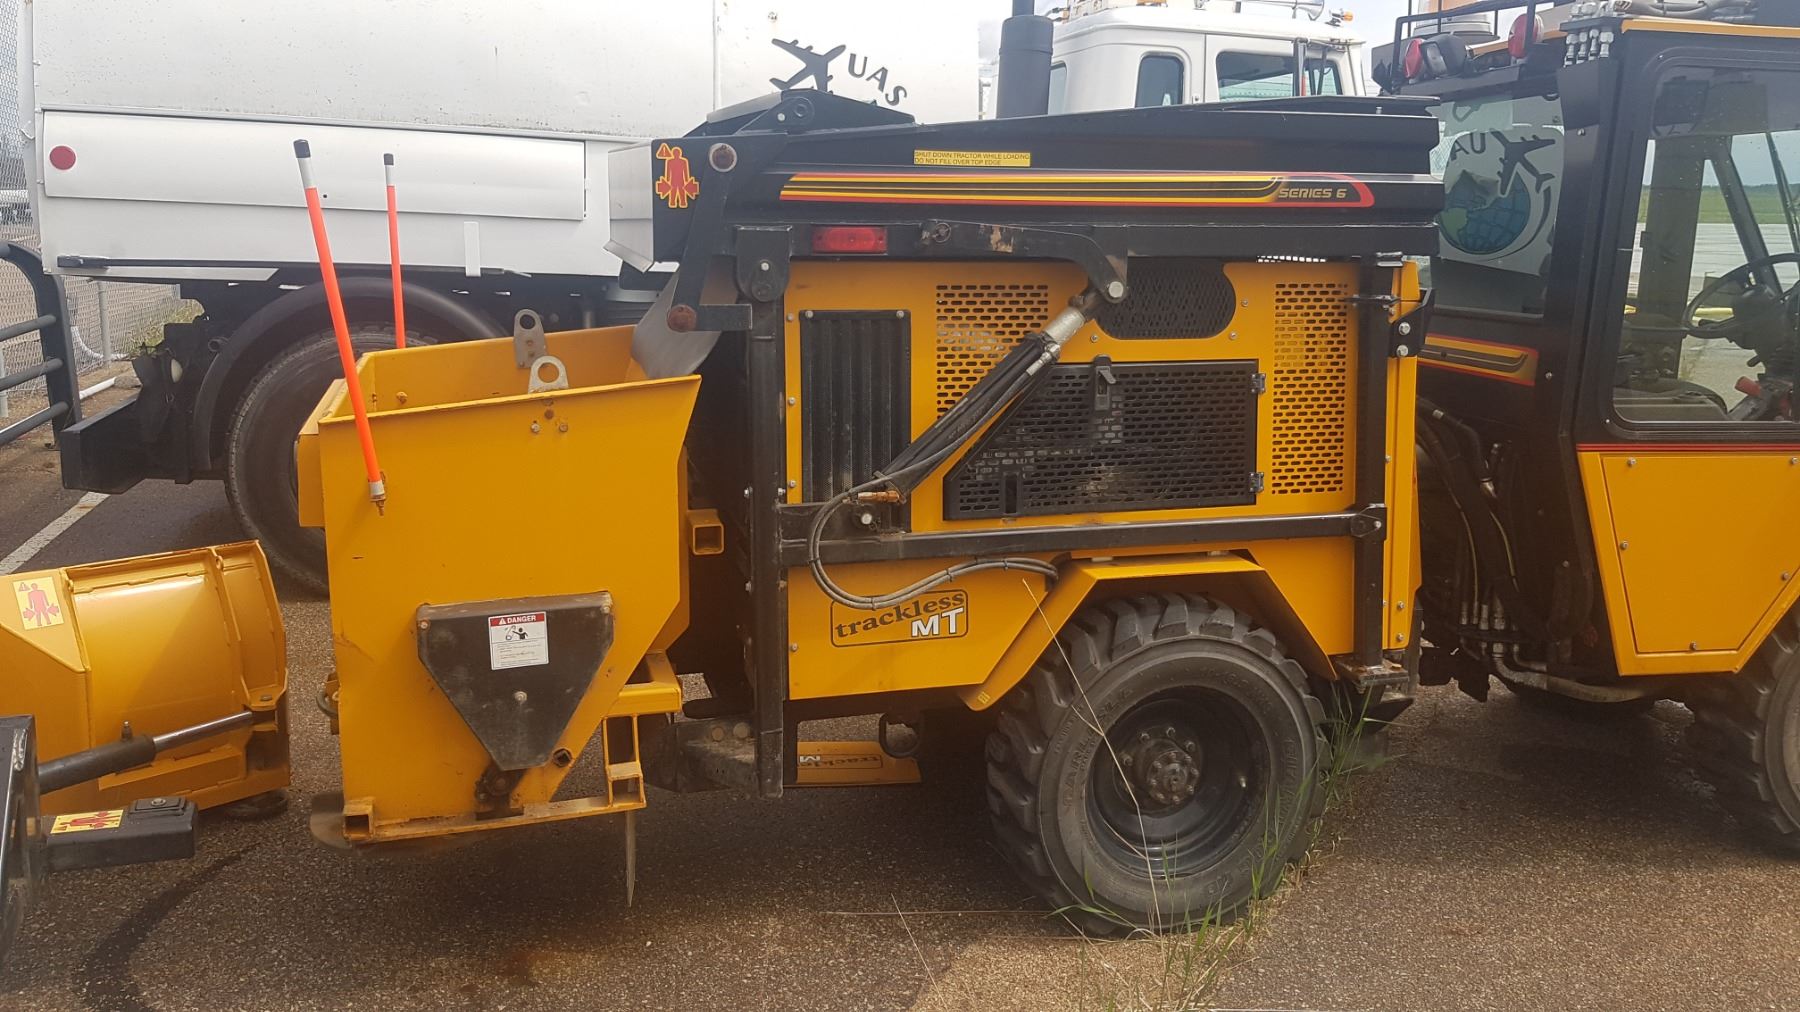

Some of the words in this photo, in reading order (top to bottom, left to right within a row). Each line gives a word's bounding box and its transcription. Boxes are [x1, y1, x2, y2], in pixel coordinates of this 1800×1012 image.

[848, 53, 907, 106] UAS
[1278, 188, 1333, 199] SERIES
[1336, 188, 1348, 199] 6
[506, 615, 537, 624] DANGER
[835, 593, 965, 638] trackless
[911, 606, 965, 638] MT
